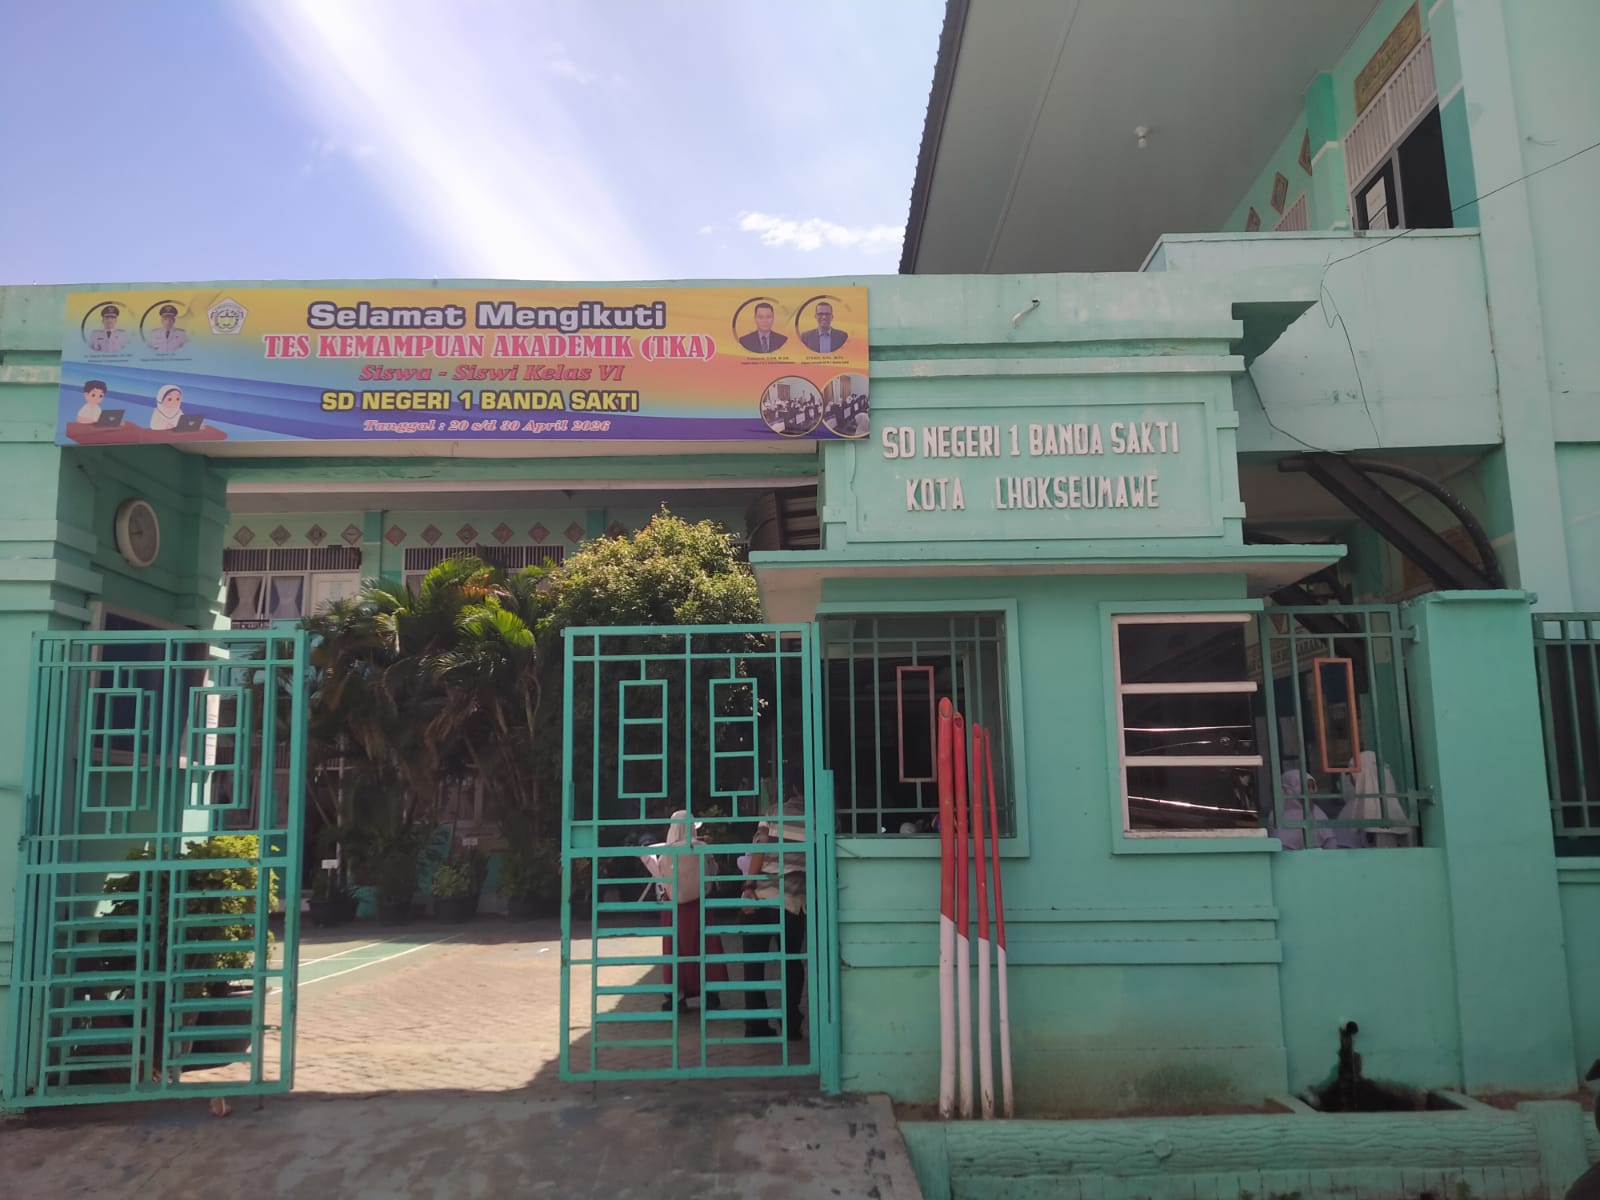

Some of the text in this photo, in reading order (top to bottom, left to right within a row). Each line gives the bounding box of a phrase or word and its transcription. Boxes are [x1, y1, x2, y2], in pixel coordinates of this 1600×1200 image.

[307, 300, 666, 334] Selamat Mengikuti
[263, 333, 717, 362] TES KEMAMPUAN AKADEMIK (TKA)
[358, 364, 433, 382] Siswa
[452, 364, 519, 381] Siswi
[523, 364, 592, 381] Kelas
[597, 364, 625, 381] VI
[320, 389, 641, 412] SD NEGERI 1 BANDA SAKTI
[363, 420, 436, 434] Tanggal
[522, 419, 568, 434] April
[881, 420, 1181, 459] SD NEGERI 1 BANDA SAKTI
[905, 474, 1161, 512] KOTA LHOKSEUMAWE
